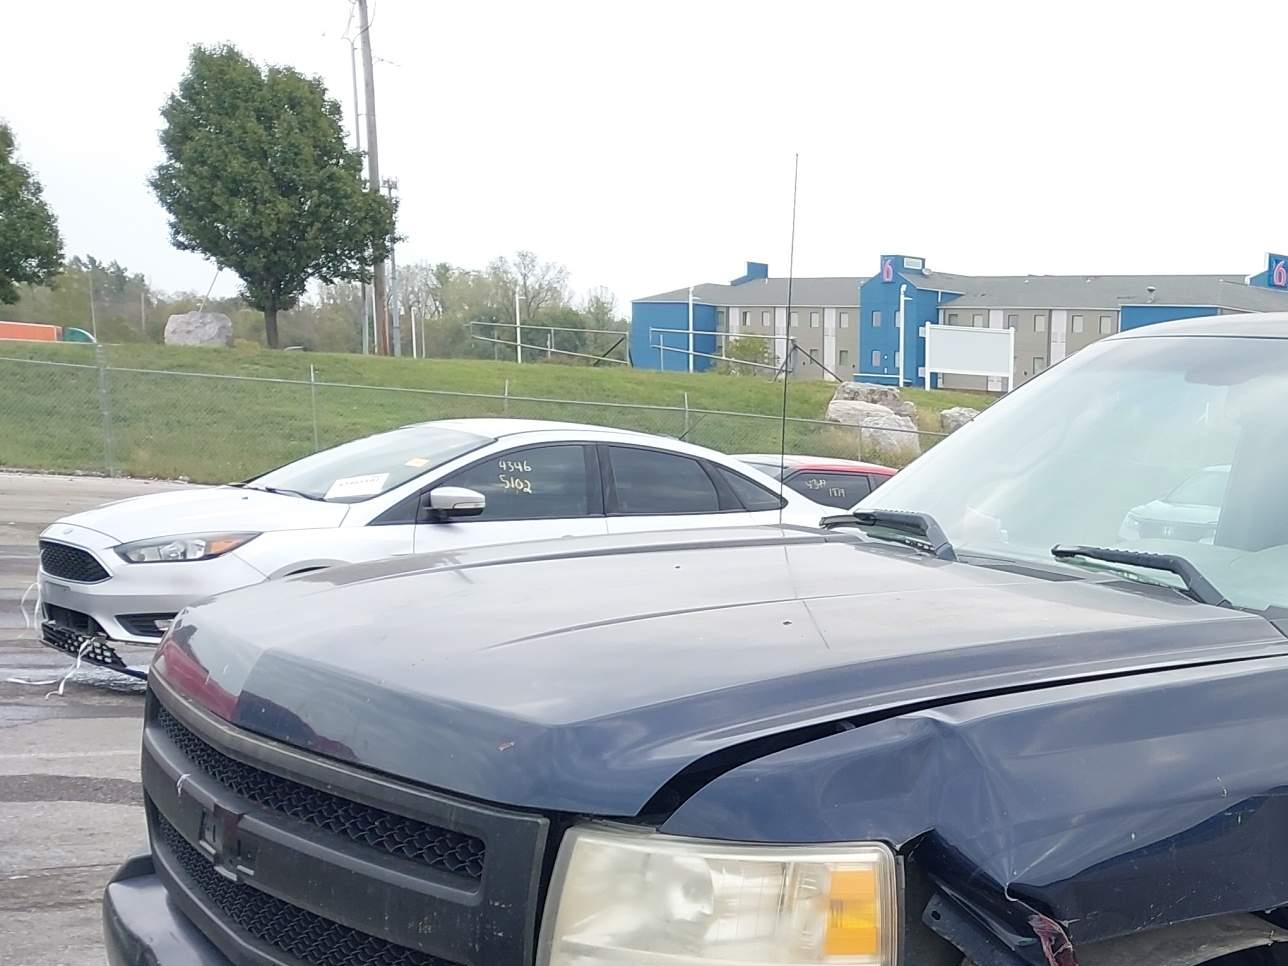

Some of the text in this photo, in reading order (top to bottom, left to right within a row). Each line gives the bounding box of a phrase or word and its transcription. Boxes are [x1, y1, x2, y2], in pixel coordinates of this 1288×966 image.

[882, 259, 894, 283] 6
[1273, 260, 1288, 287] 6
[498, 460, 532, 472] 4346
[498, 474, 533, 494] 5102
